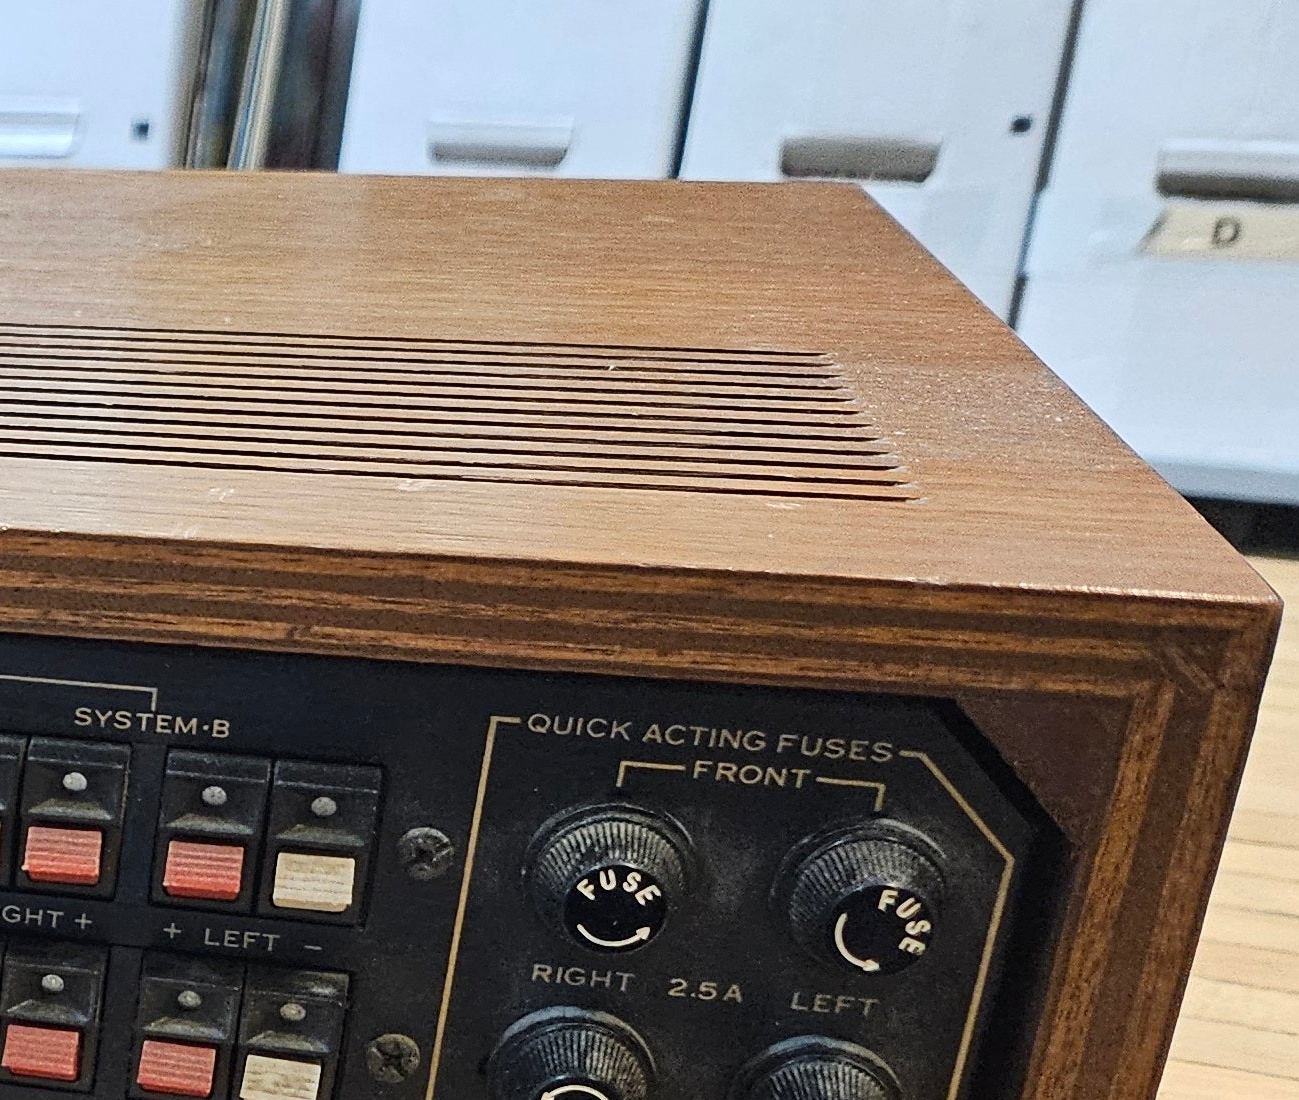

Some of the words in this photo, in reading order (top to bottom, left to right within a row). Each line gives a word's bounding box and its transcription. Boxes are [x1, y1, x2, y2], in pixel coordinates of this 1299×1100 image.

[1212, 216, 1241, 247] D
[527, 713, 632, 741] QUICK
[642, 725, 766, 752] ACTING
[778, 734, 894, 761] FUSES
[693, 760, 811, 789] FRONT
[576, 870, 663, 908] FUSE
[205, 929, 281, 953] LEFT
[877, 888, 932, 957] FUSE
[532, 964, 636, 992] RIGHT
[790, 992, 881, 1018] LEFT
